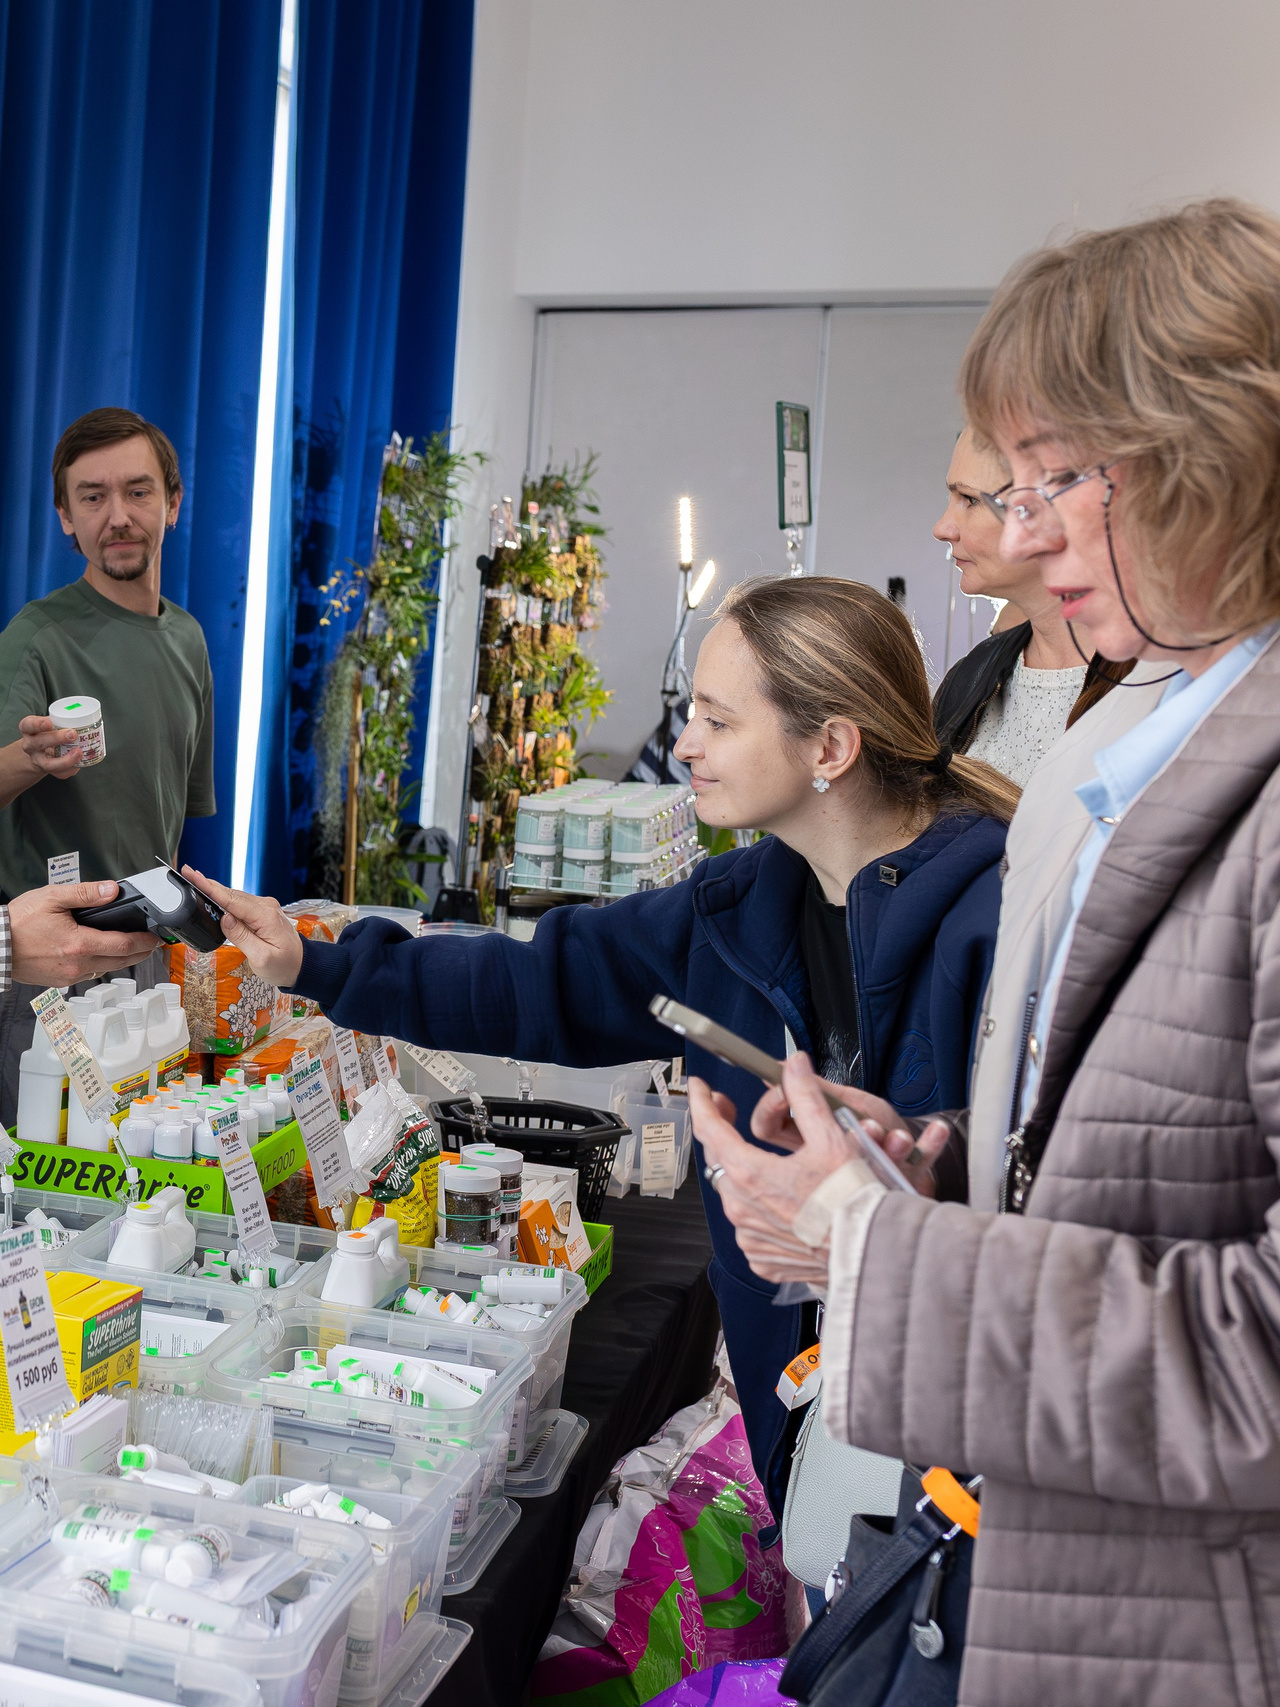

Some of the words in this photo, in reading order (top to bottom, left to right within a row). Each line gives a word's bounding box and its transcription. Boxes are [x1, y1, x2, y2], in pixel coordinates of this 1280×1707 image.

[294, 1059, 320, 1084] DYNA-GRO
[272, 1148, 295, 1178] FOOD
[48, 1327, 56, 1337] для
[23, 1366, 39, 1389] 500
[42, 1357, 58, 1384] руб
[82, 1380, 93, 1395] Gold
